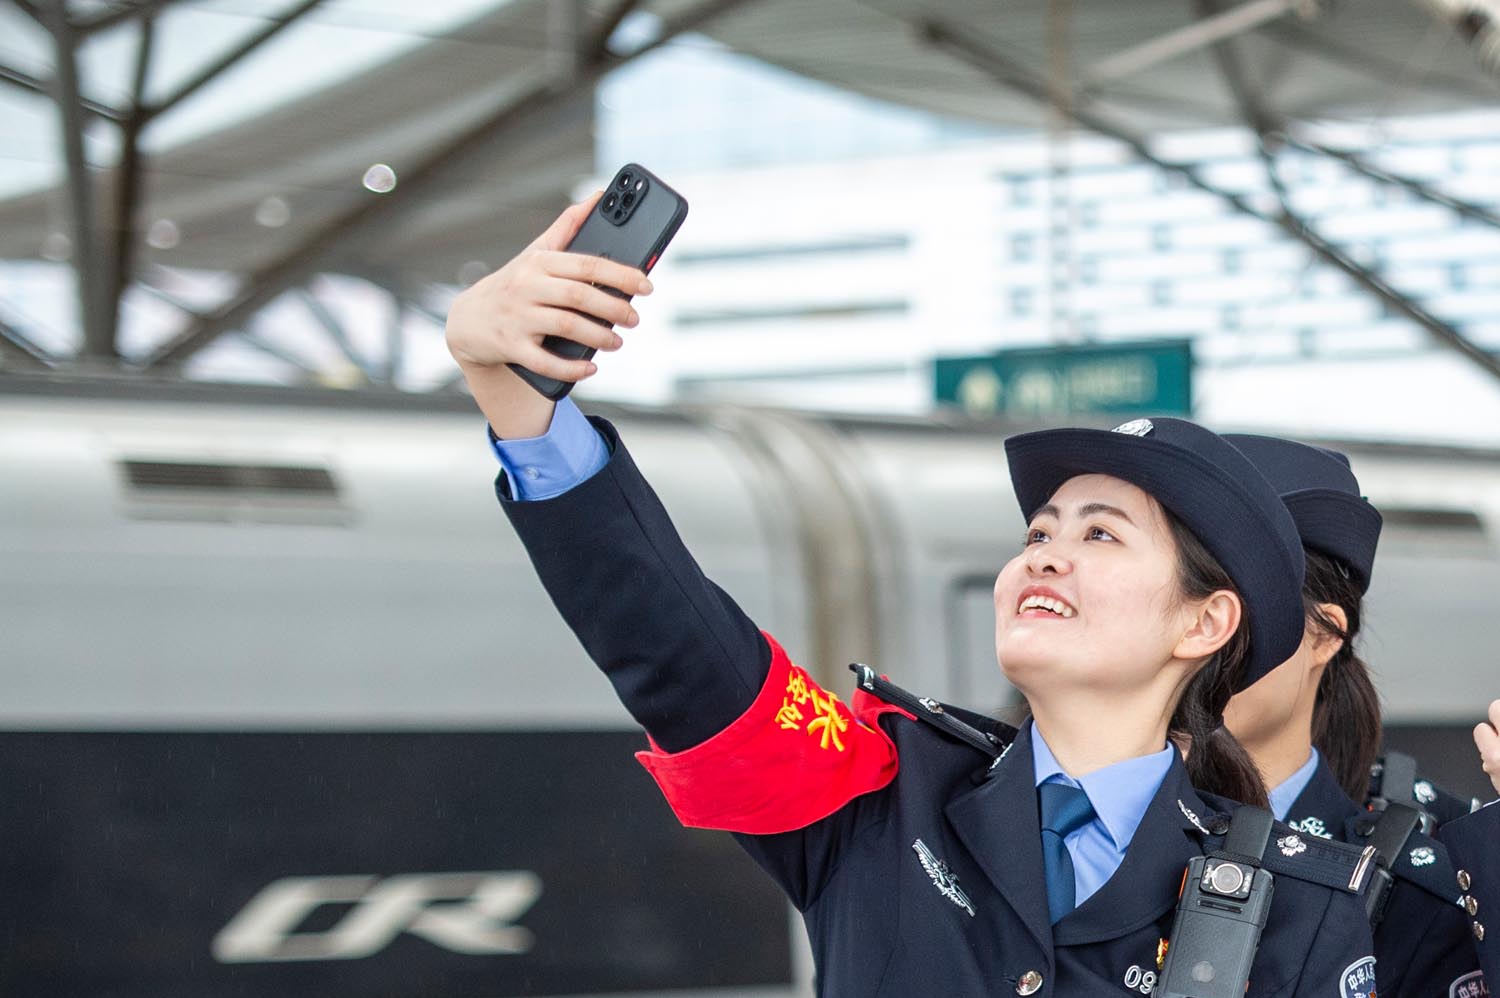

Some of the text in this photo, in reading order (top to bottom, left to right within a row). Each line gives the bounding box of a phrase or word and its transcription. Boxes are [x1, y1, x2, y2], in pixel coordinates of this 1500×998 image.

[775, 670, 811, 730] 安处
[807, 688, 849, 752] 长
[211, 869, 543, 964] CR
